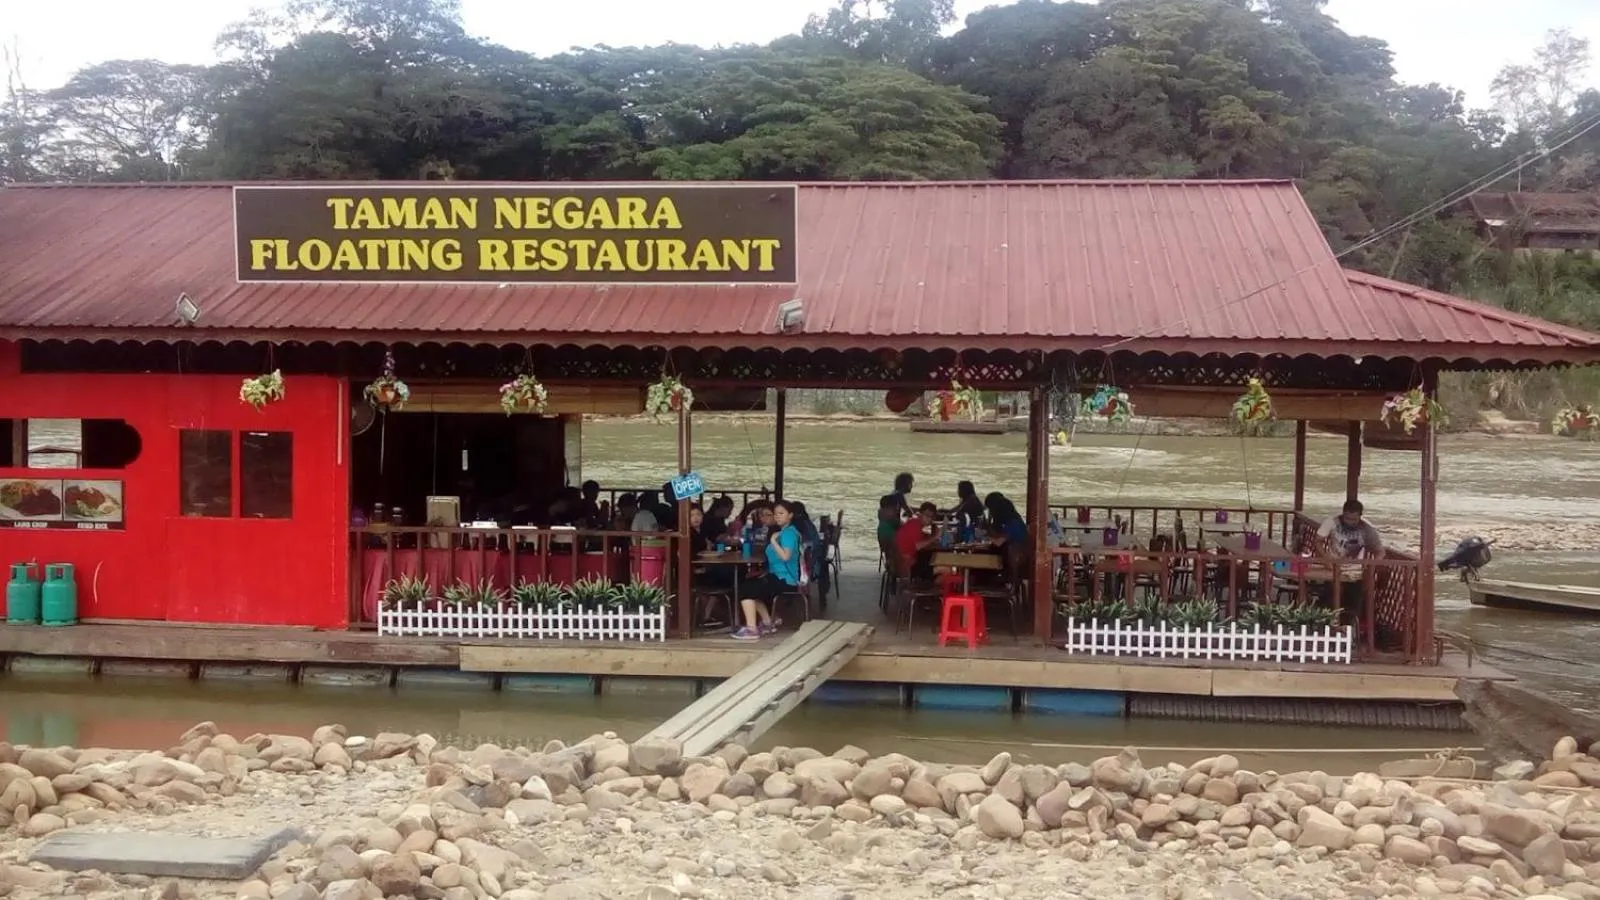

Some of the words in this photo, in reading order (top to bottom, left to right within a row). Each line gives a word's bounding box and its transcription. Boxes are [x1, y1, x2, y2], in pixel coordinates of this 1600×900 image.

[327, 197, 478, 229] TAMAN
[494, 197, 682, 229] NEGARA
[250, 239, 463, 272] FLOATING
[478, 239, 781, 272] RESTAURANT
[675, 478, 702, 494] OPEN
